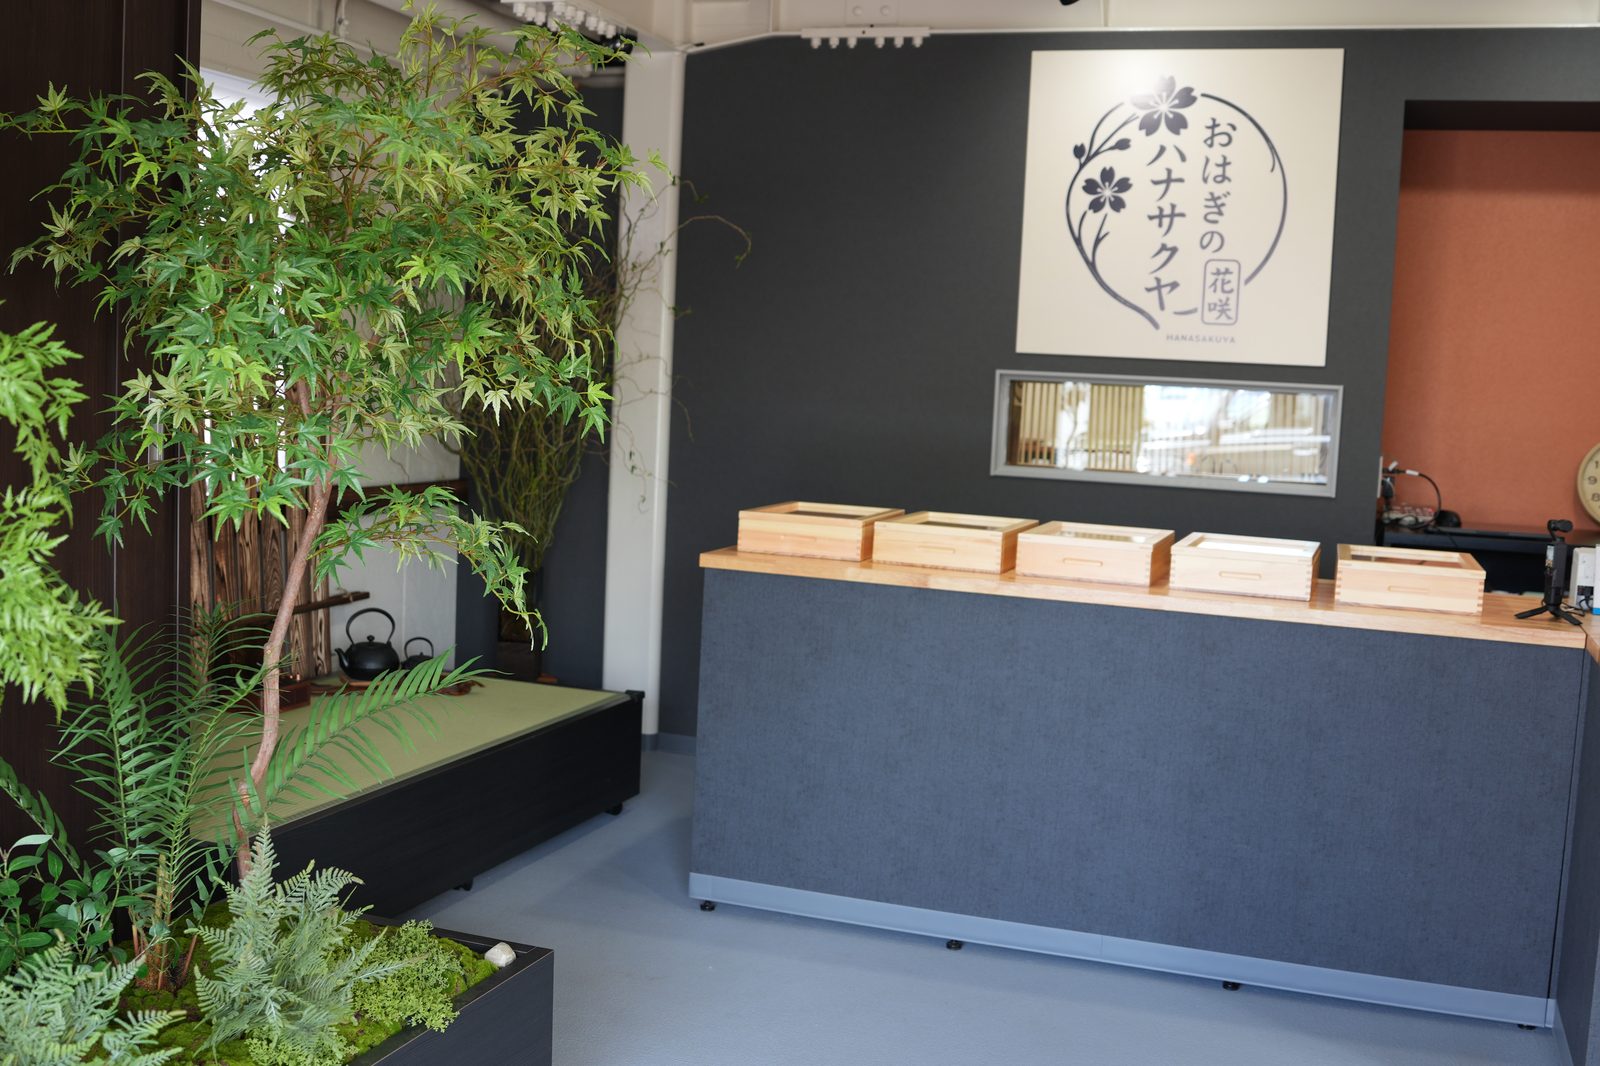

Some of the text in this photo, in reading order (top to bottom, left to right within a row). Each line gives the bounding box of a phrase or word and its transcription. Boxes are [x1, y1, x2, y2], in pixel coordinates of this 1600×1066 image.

[1199, 117, 1237, 253] おはぎの
[1144, 144, 1187, 311] ハナサクヤ
[1208, 267, 1234, 320] 花咲
[1166, 333, 1236, 344] HANASAKUYA
[1588, 475, 1598, 485] 9
